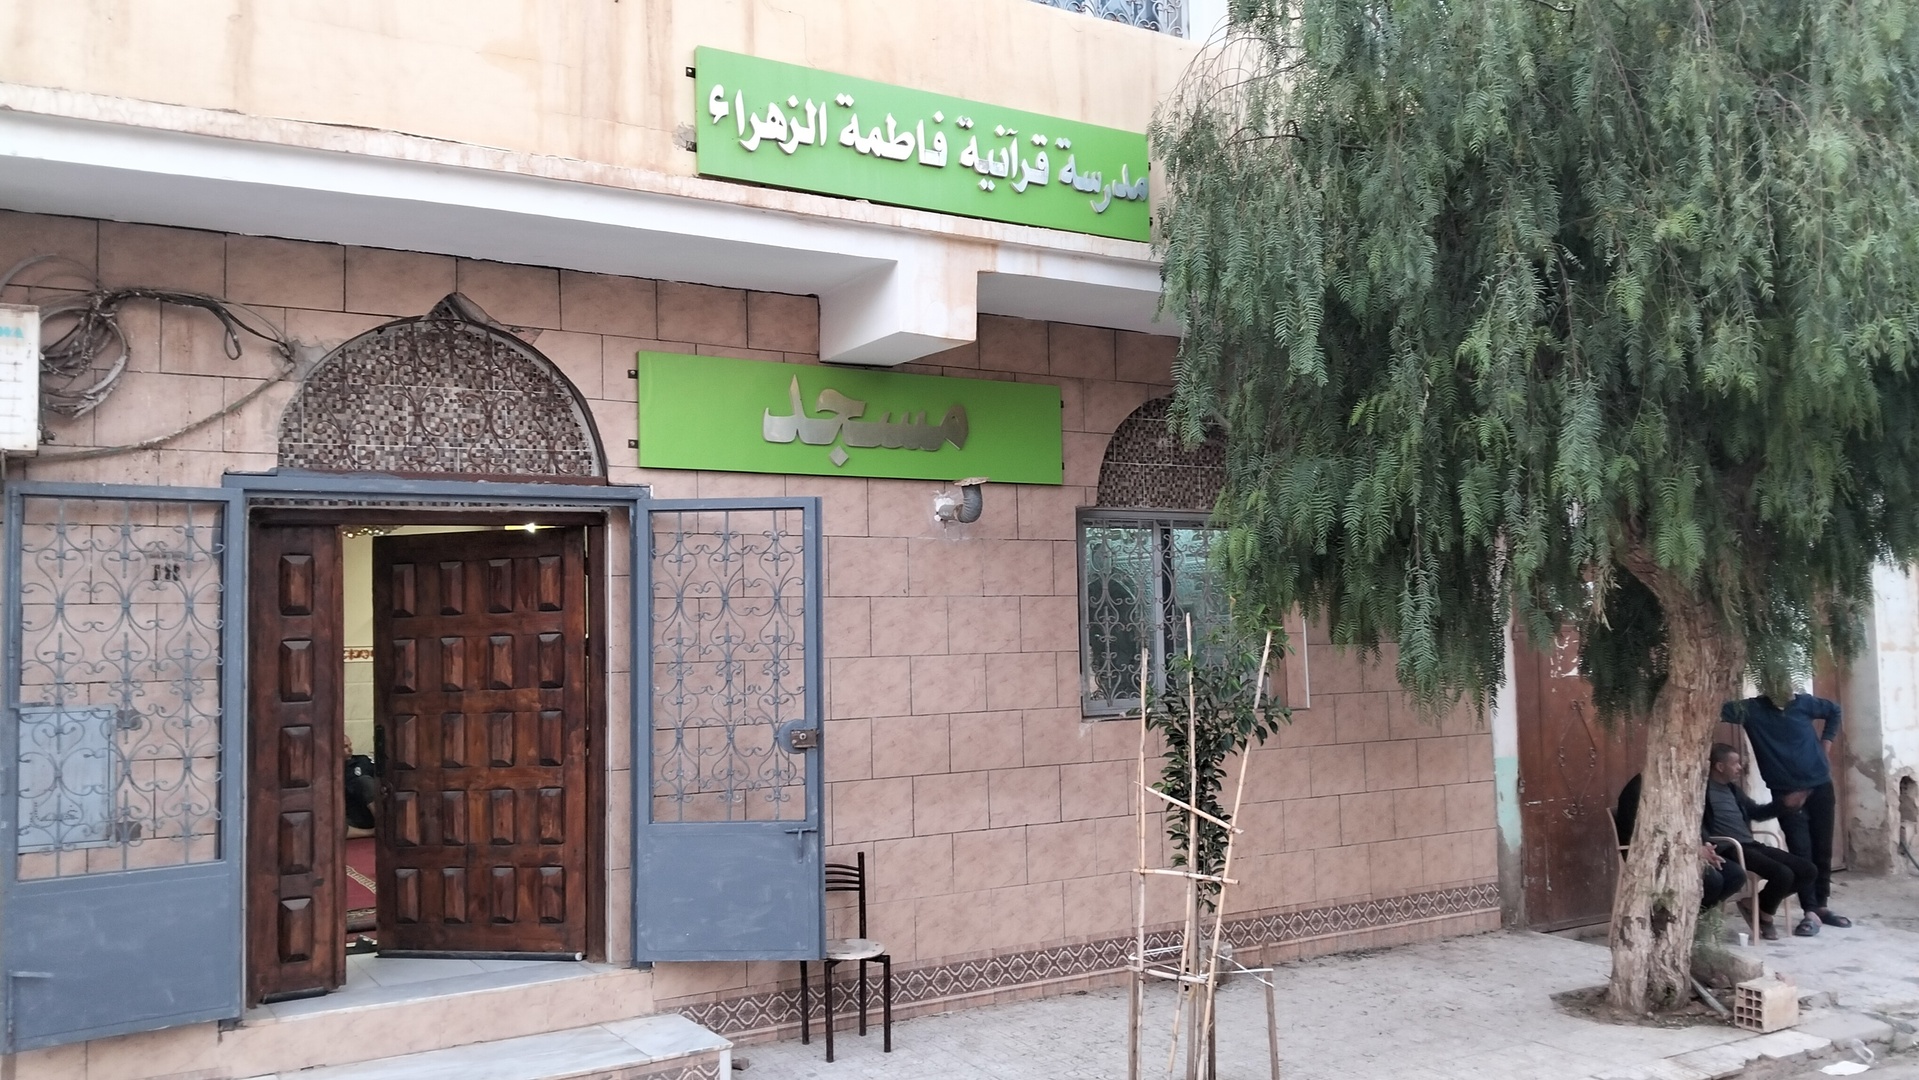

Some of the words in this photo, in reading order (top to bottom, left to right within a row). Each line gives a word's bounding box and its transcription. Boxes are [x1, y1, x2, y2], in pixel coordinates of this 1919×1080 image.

[709, 83, 828, 155] الزهراء
[834, 93, 948, 169] فاطمة
[956, 114, 1050, 193] قرآنية
[1055, 137, 1149, 214] مدرسة
[762, 373, 969, 467] مسجد
